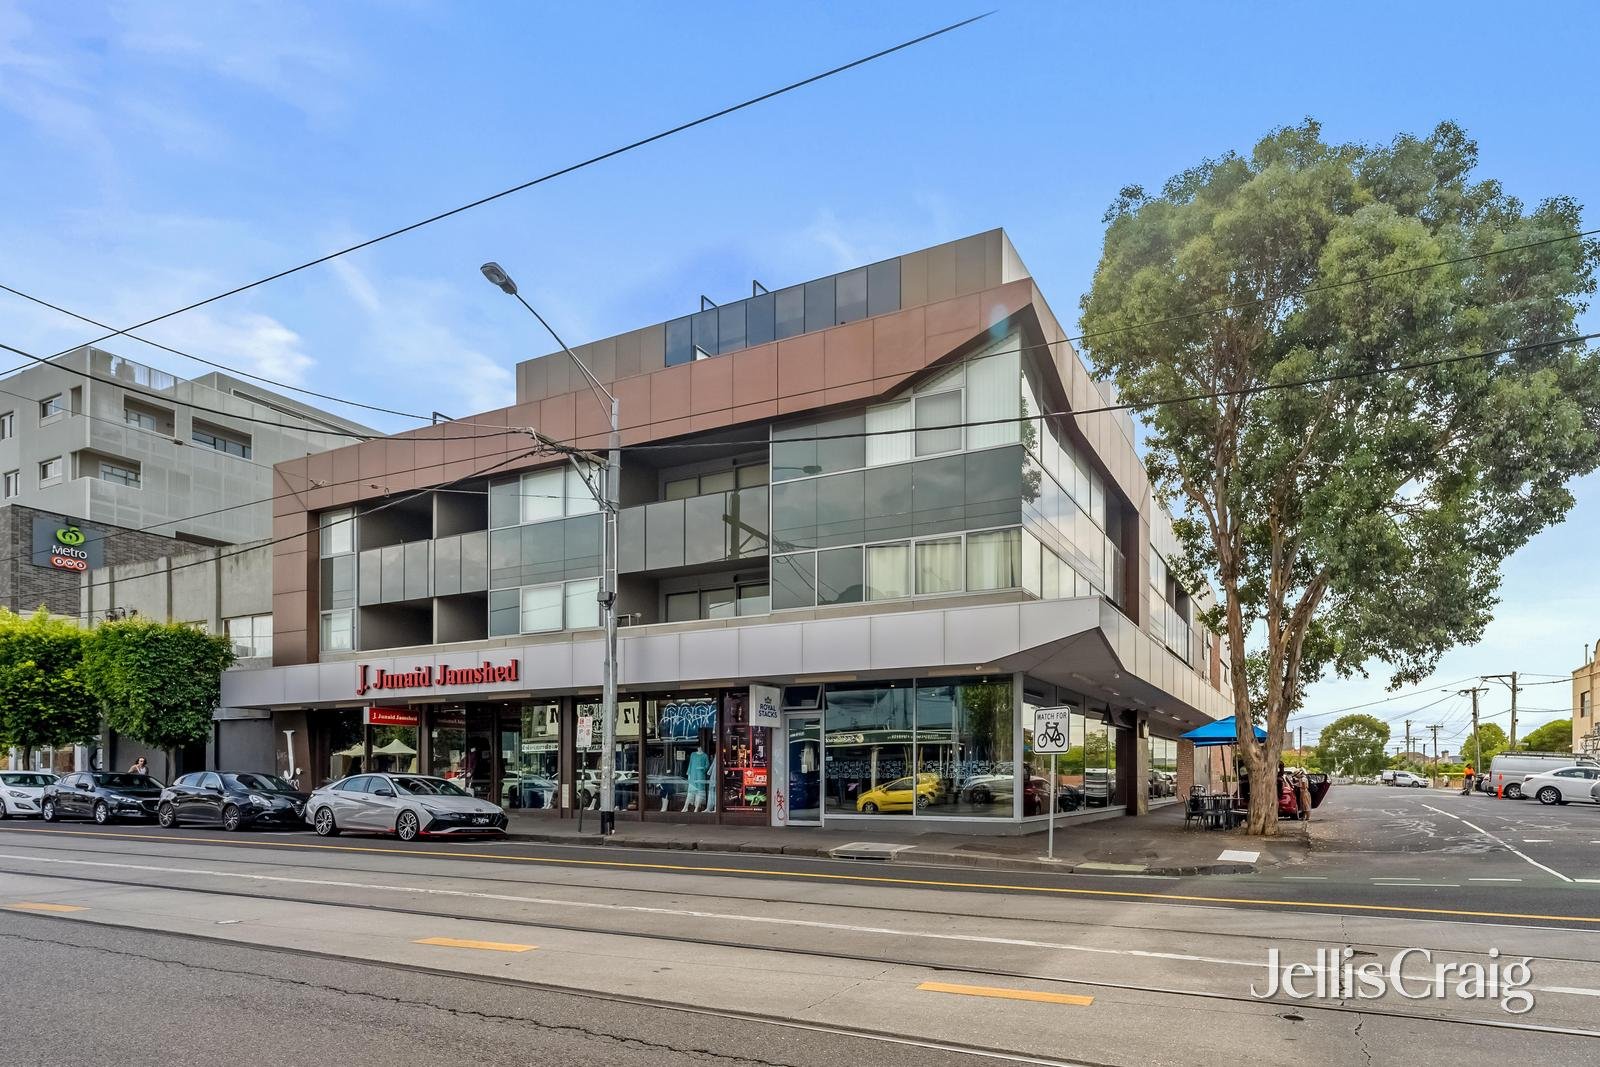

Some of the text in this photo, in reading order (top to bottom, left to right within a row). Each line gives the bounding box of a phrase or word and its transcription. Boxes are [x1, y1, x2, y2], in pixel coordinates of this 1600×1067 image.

[52, 545, 87, 559] Metro
[357, 659, 519, 695] J. Junaid Jamshed
[760, 703, 776, 711] ROYAL
[759, 710, 778, 718] STACKS
[1037, 712, 1055, 720] WATCH
